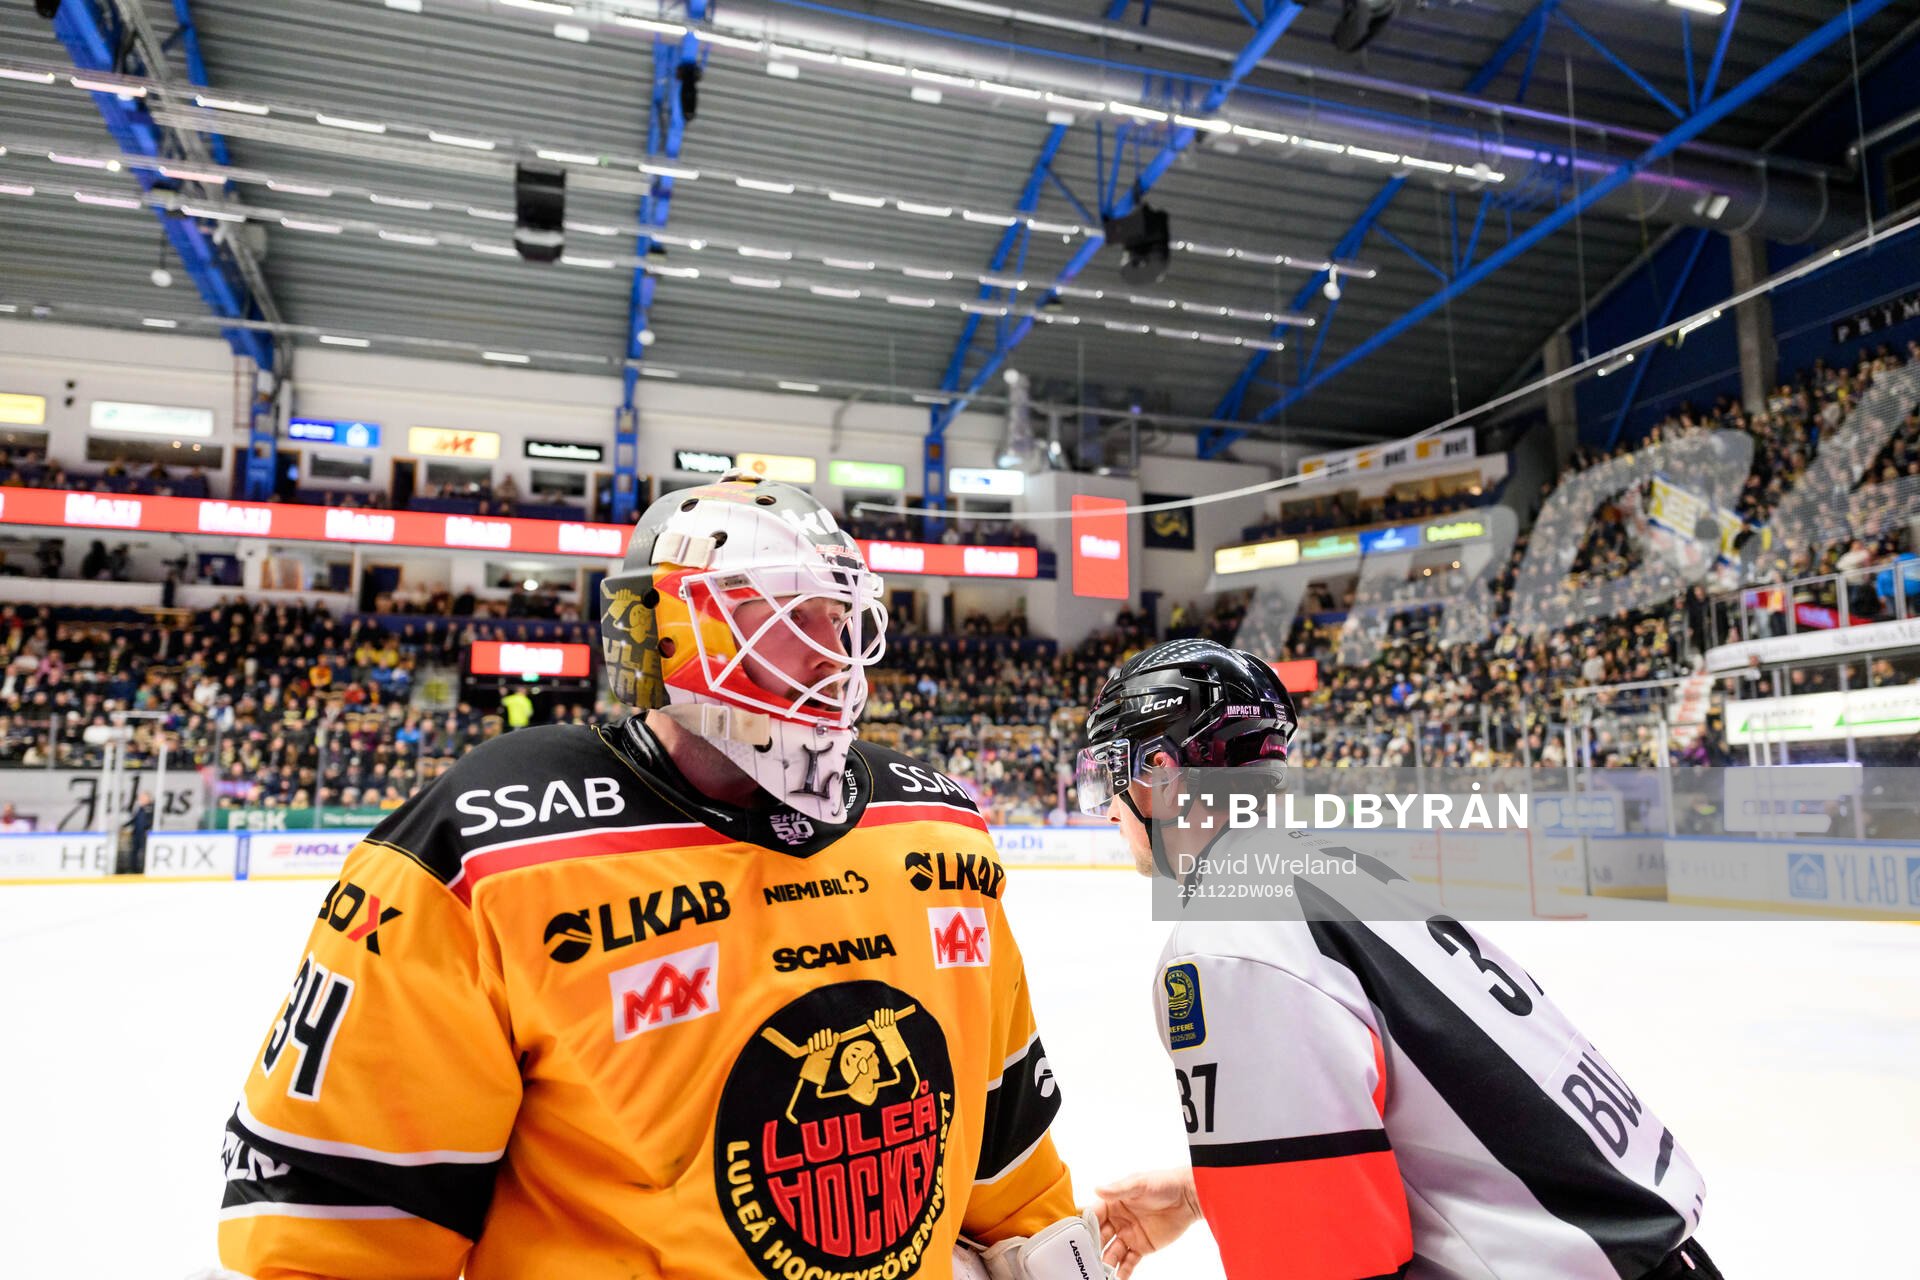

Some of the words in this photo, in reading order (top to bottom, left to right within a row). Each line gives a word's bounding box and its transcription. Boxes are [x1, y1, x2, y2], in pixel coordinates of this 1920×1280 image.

[1140, 695, 1184, 714] CCM
[1227, 705, 1251, 716] IMPACT
[1252, 706, 1261, 716] BY
[455, 777, 626, 837] SSAB
[889, 762, 971, 800] SSA
[771, 820, 815, 841] 50
[598, 881, 731, 952] LKAB
[763, 877, 820, 906] NIEMI
[772, 933, 897, 973] SCANIA
[934, 911, 986, 964] MAX
[1426, 914, 1544, 1017] 3
[261, 953, 354, 1101] 34
[623, 962, 710, 1034] MAX
[762, 1080, 937, 1175] LULEÅ
[1175, 1062, 1218, 1134] 37
[727, 1140, 776, 1243] LULEÅ
[767, 1134, 937, 1258] HOCKEY
